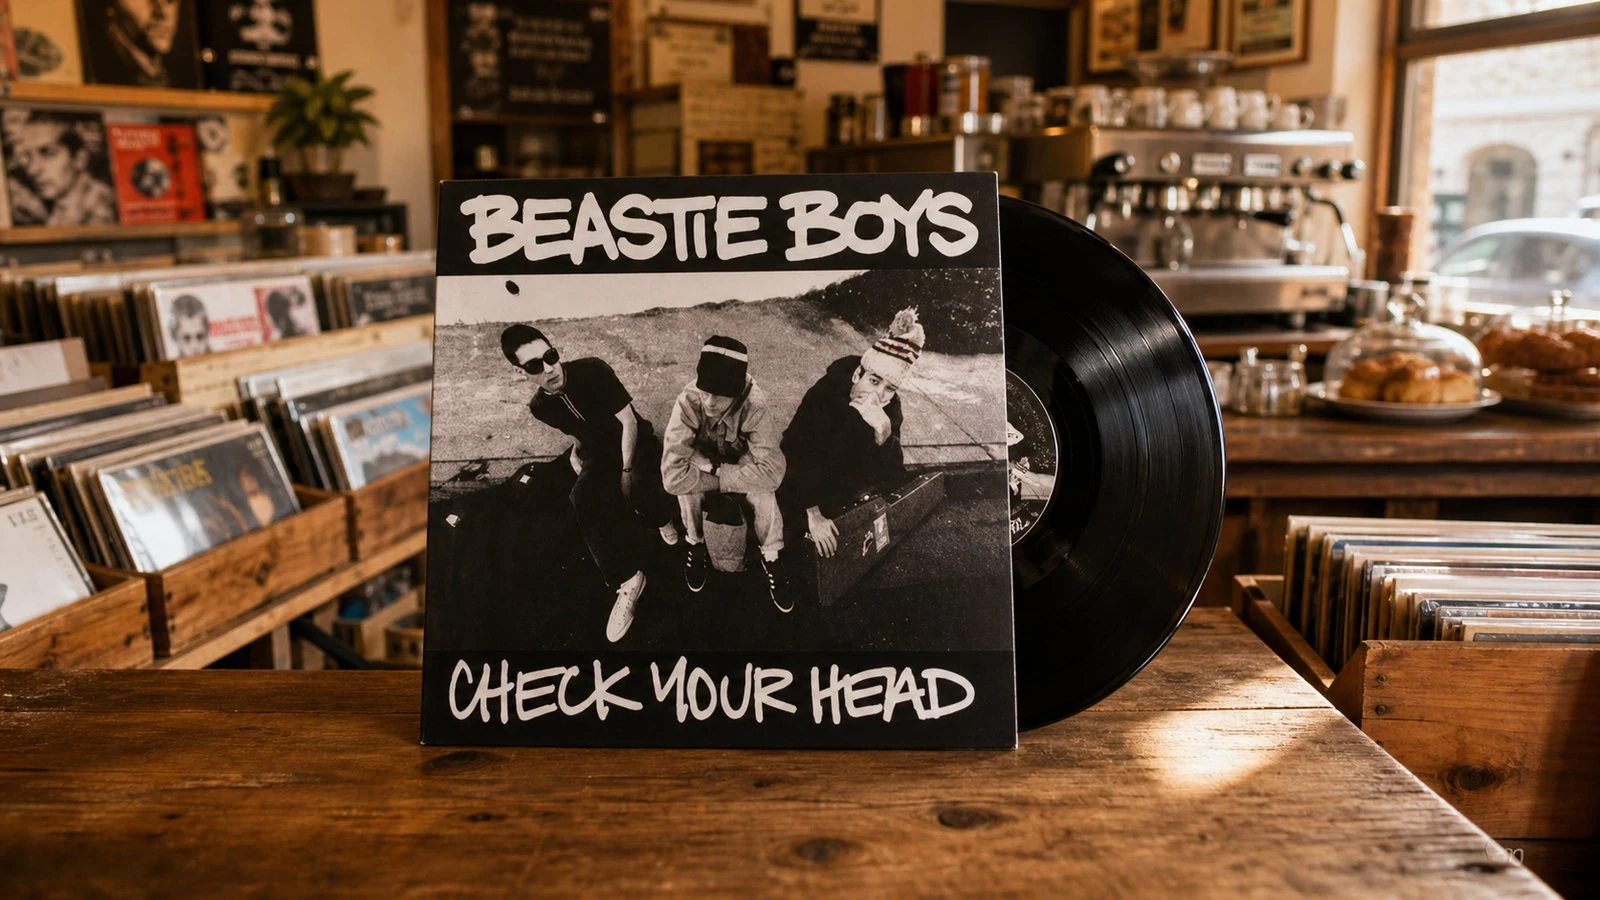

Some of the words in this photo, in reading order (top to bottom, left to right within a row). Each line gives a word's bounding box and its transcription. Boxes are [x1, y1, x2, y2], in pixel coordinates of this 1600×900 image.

[460, 192, 769, 266] BEASTIE
[778, 188, 979, 262] BOYS
[448, 658, 644, 725] CHECK
[651, 655, 798, 723] YOUR
[810, 663, 976, 725] HEAD
